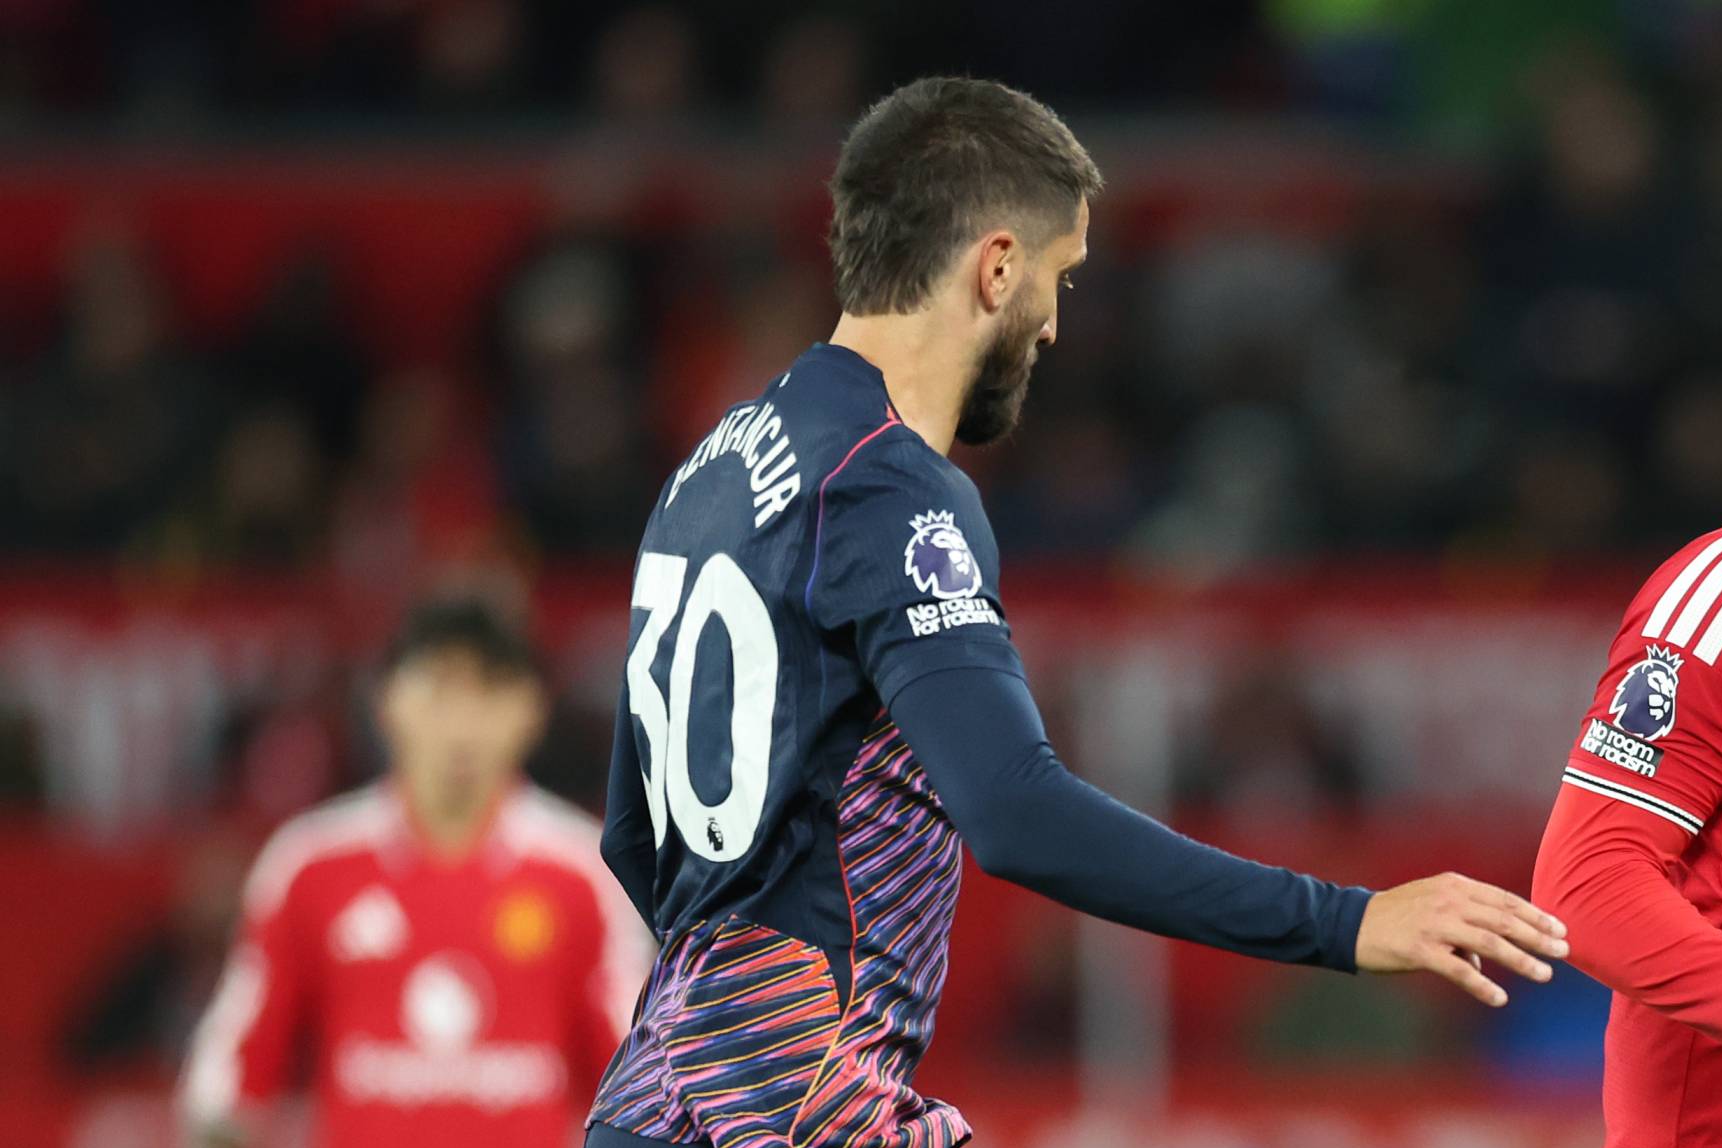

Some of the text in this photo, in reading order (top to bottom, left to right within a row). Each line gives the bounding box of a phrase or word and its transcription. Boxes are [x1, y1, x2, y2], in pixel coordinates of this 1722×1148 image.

[906, 598, 990, 622] No room
[912, 610, 1001, 637] for racm
[626, 552, 779, 863] 30
[1586, 718, 1655, 762] No room
[1598, 744, 1656, 778] racism
